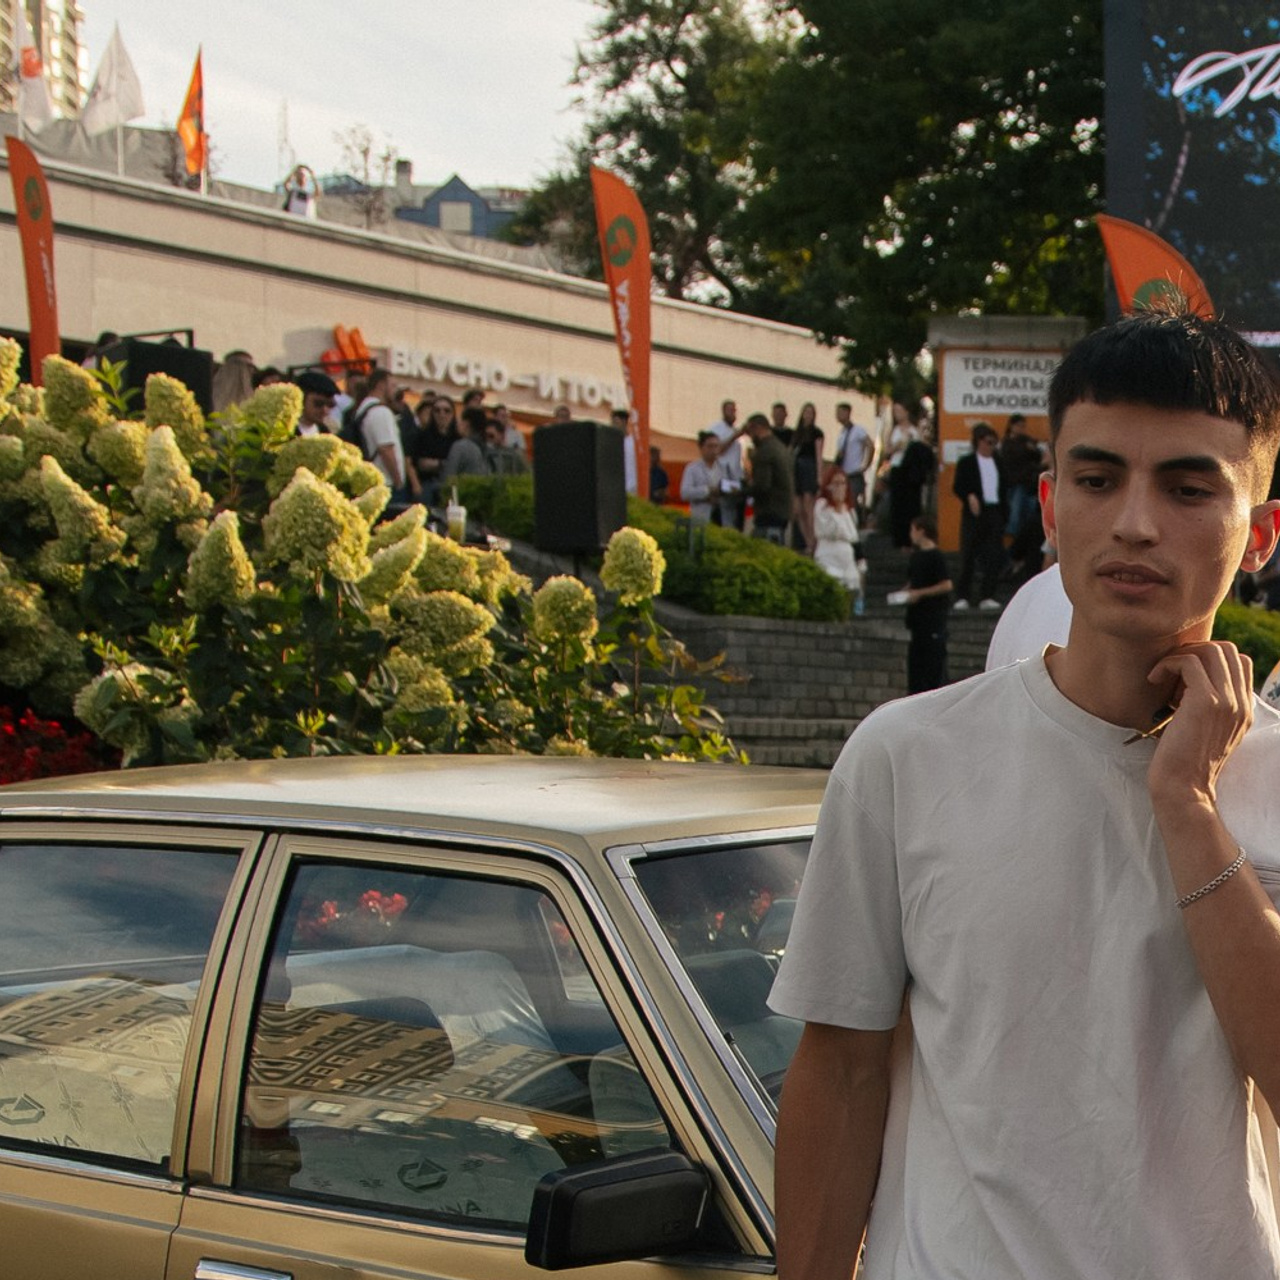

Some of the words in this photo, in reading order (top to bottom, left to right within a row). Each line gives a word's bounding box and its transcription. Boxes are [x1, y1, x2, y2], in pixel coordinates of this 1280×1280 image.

[390, 346, 510, 393] ВКУСНО
[538, 371, 561, 400] И
[563, 374, 629, 411] ТОЧ
[972, 375, 1045, 391] ОПЛАТЫ
